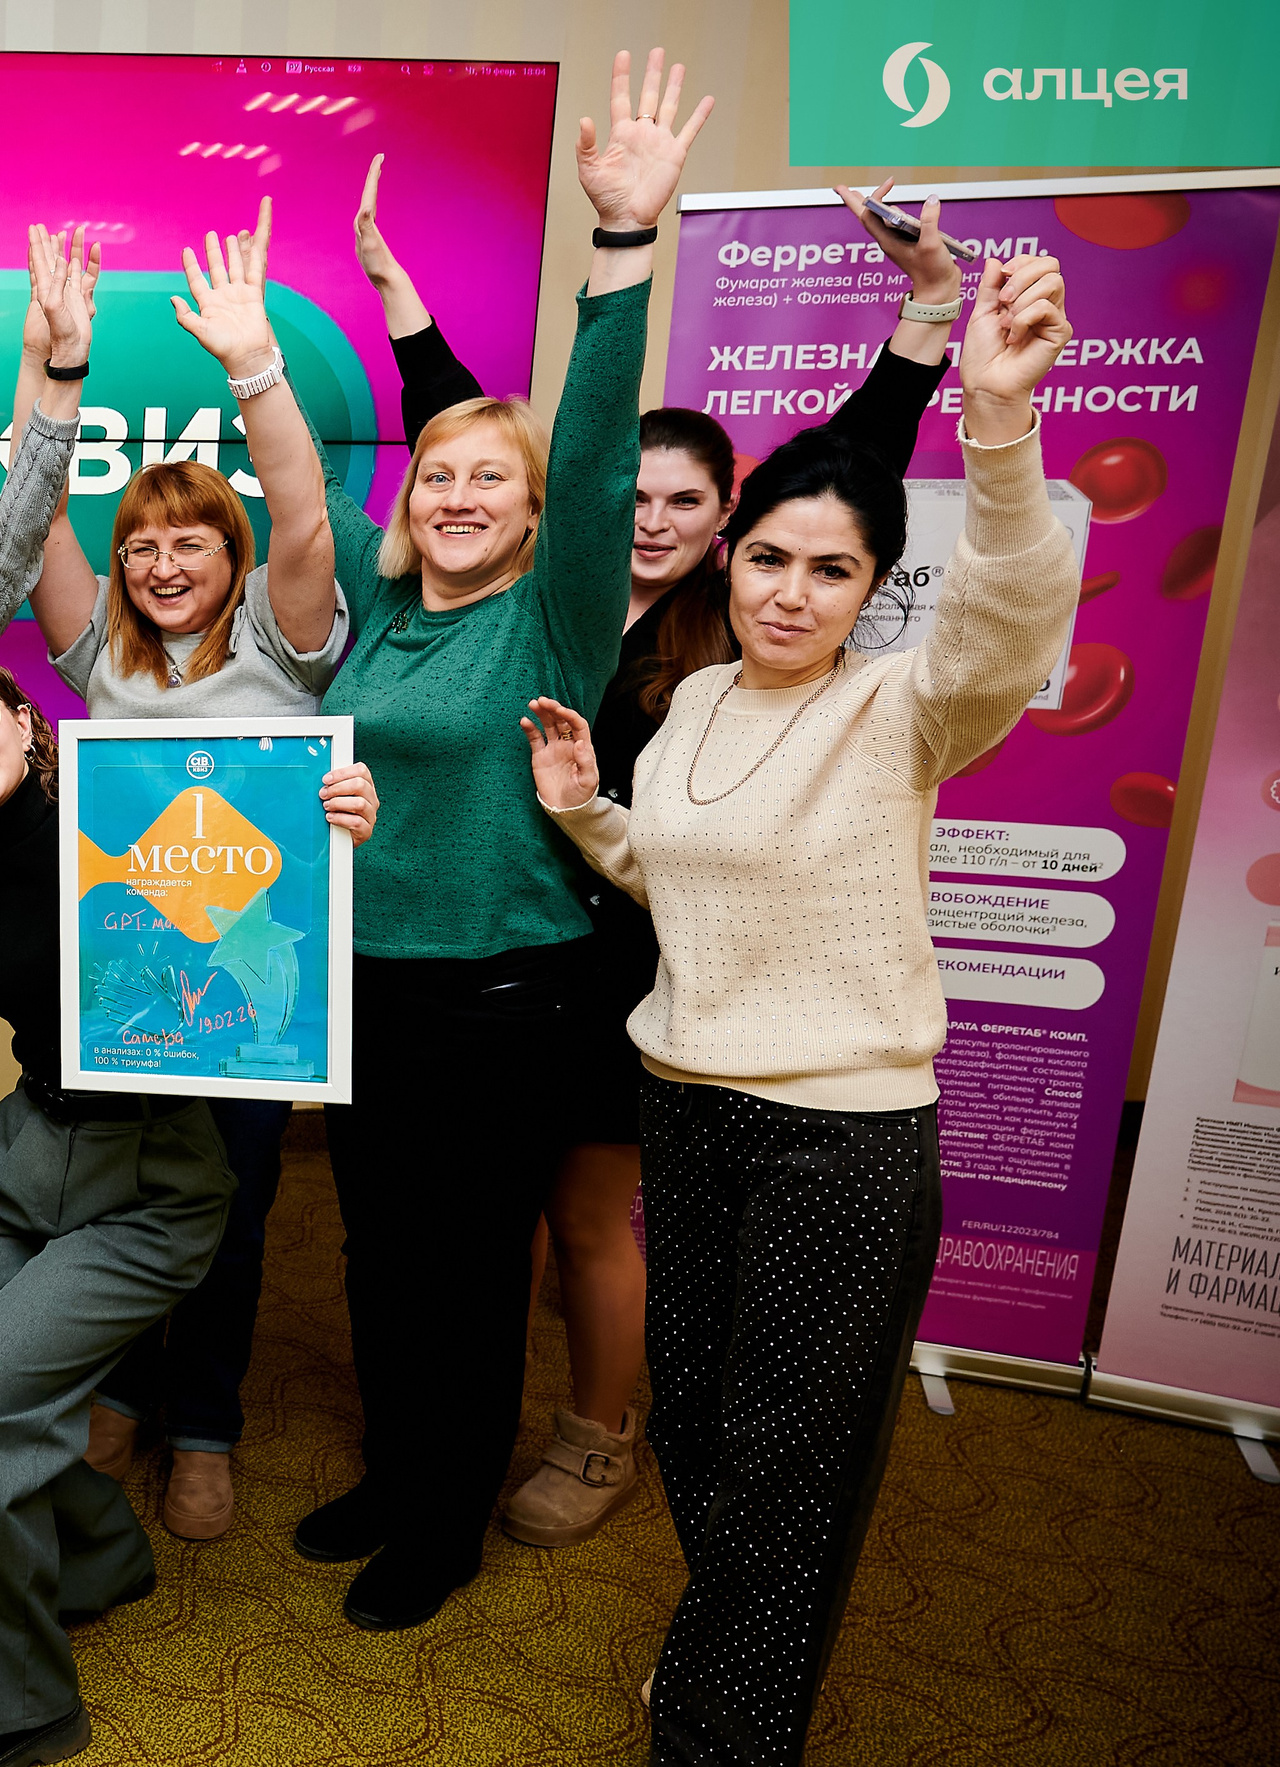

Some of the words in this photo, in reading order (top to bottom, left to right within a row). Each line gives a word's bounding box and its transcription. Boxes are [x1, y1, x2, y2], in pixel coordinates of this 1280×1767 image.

[304, 64, 335, 74] Русская
[717, 240, 885, 272] Феррета
[953, 236, 1049, 261] омп.
[715, 275, 788, 290] Фумарат
[790, 274, 853, 289] железа
[856, 272, 882, 289] (50
[886, 273, 908, 286] мг
[712, 293, 778, 308] железа)
[782, 295, 792, 306] +
[797, 290, 880, 306] Фолиевая
[707, 343, 885, 371] ЖЕЛЕЗН
[702, 382, 853, 416] ЛЕГКОЙ
[935, 826, 1010, 841] ЭФФЕКТ:
[928, 854, 958, 864] олее
[962, 854, 986, 866] 110
[988, 856, 1008, 867] г/л
[1022, 859, 1037, 869] от
[1041, 859, 1058, 870] 10
[929, 843, 950, 853] ал,
[958, 843, 1059, 859] необходимый
[1062, 851, 1091, 862] для
[125, 877, 193, 889] награждается
[125, 886, 169, 898] команда:
[929, 891, 1050, 910] ВОБОЖДЕНИЕ
[927, 918, 977, 930] зистые
[1027, 915, 1088, 928] железа,
[937, 959, 1066, 980] ЕКОМЕНДАЦИИ
[945, 1021, 979, 1032] АРАТА
[1049, 1030, 1089, 1043] КОМП.
[101, 1046, 143, 1057] анализах:
[145, 1048, 152, 1056] 0
[153, 1048, 161, 1057] %
[163, 1049, 200, 1060] ошибок,
[950, 1038, 990, 1049] капсулы
[991, 1041, 1089, 1058] пролонгированного
[94, 1056, 110, 1065] 100
[111, 1057, 119, 1065] %
[120, 1057, 162, 1068] триумфа!
[995, 1052, 1044, 1064] фолиевая
[1047, 1057, 1088, 1069] кислота
[935, 1067, 1046, 1085] желудочно-кишечного
[1048, 1078, 1084, 1089] тракта,
[1032, 1066, 1085, 1079] состояний,
[936, 1078, 981, 1088] оценным
[1044, 1087, 1083, 1099] Способ
[943, 1088, 987, 1099] натощак,
[992, 1092, 1034, 1104] обильно
[1039, 1098, 1081, 1109] запивая
[938, 1098, 967, 1108] слоты
[968, 1101, 1000, 1111] нужно
[1002, 1104, 1053, 1117] увеличить
[1056, 1111, 1080, 1121] дозу
[943, 1109, 1002, 1121] продолжать
[1004, 1115, 1021, 1123] как
[1023, 1118, 1068, 1129] минимум
[1070, 1122, 1078, 1130] 4
[939, 1129, 988, 1140] действие:
[992, 1133, 1045, 1147] ФЕРРЕТАБ
[944, 1119, 1015, 1132] нормализации
[1020, 1127, 1076, 1140] ферритина
[938, 1139, 985, 1150] ременное
[987, 1143, 1072, 1160] неблагоприятное
[946, 1150, 1004, 1162] неприятные
[1007, 1156, 1060, 1168] ощущения
[940, 1169, 977, 1179] рукции
[977, 1172, 991, 1181] по
[992, 1175, 1068, 1192] медицинскому
[964, 1160, 971, 1168] 3
[1000, 1165, 1014, 1173] Не
[1016, 1167, 1069, 1181] применять
[962, 1220, 1060, 1240] FER/RU/122023/784
[935, 1236, 1080, 1281] ДРАВООХРАНЕНИЯ
[1172, 1235, 1280, 1281] МАТЕРИАЛ
[1165, 1267, 1181, 1295] И
[1189, 1272, 1280, 1317] ФАРМАЦ
